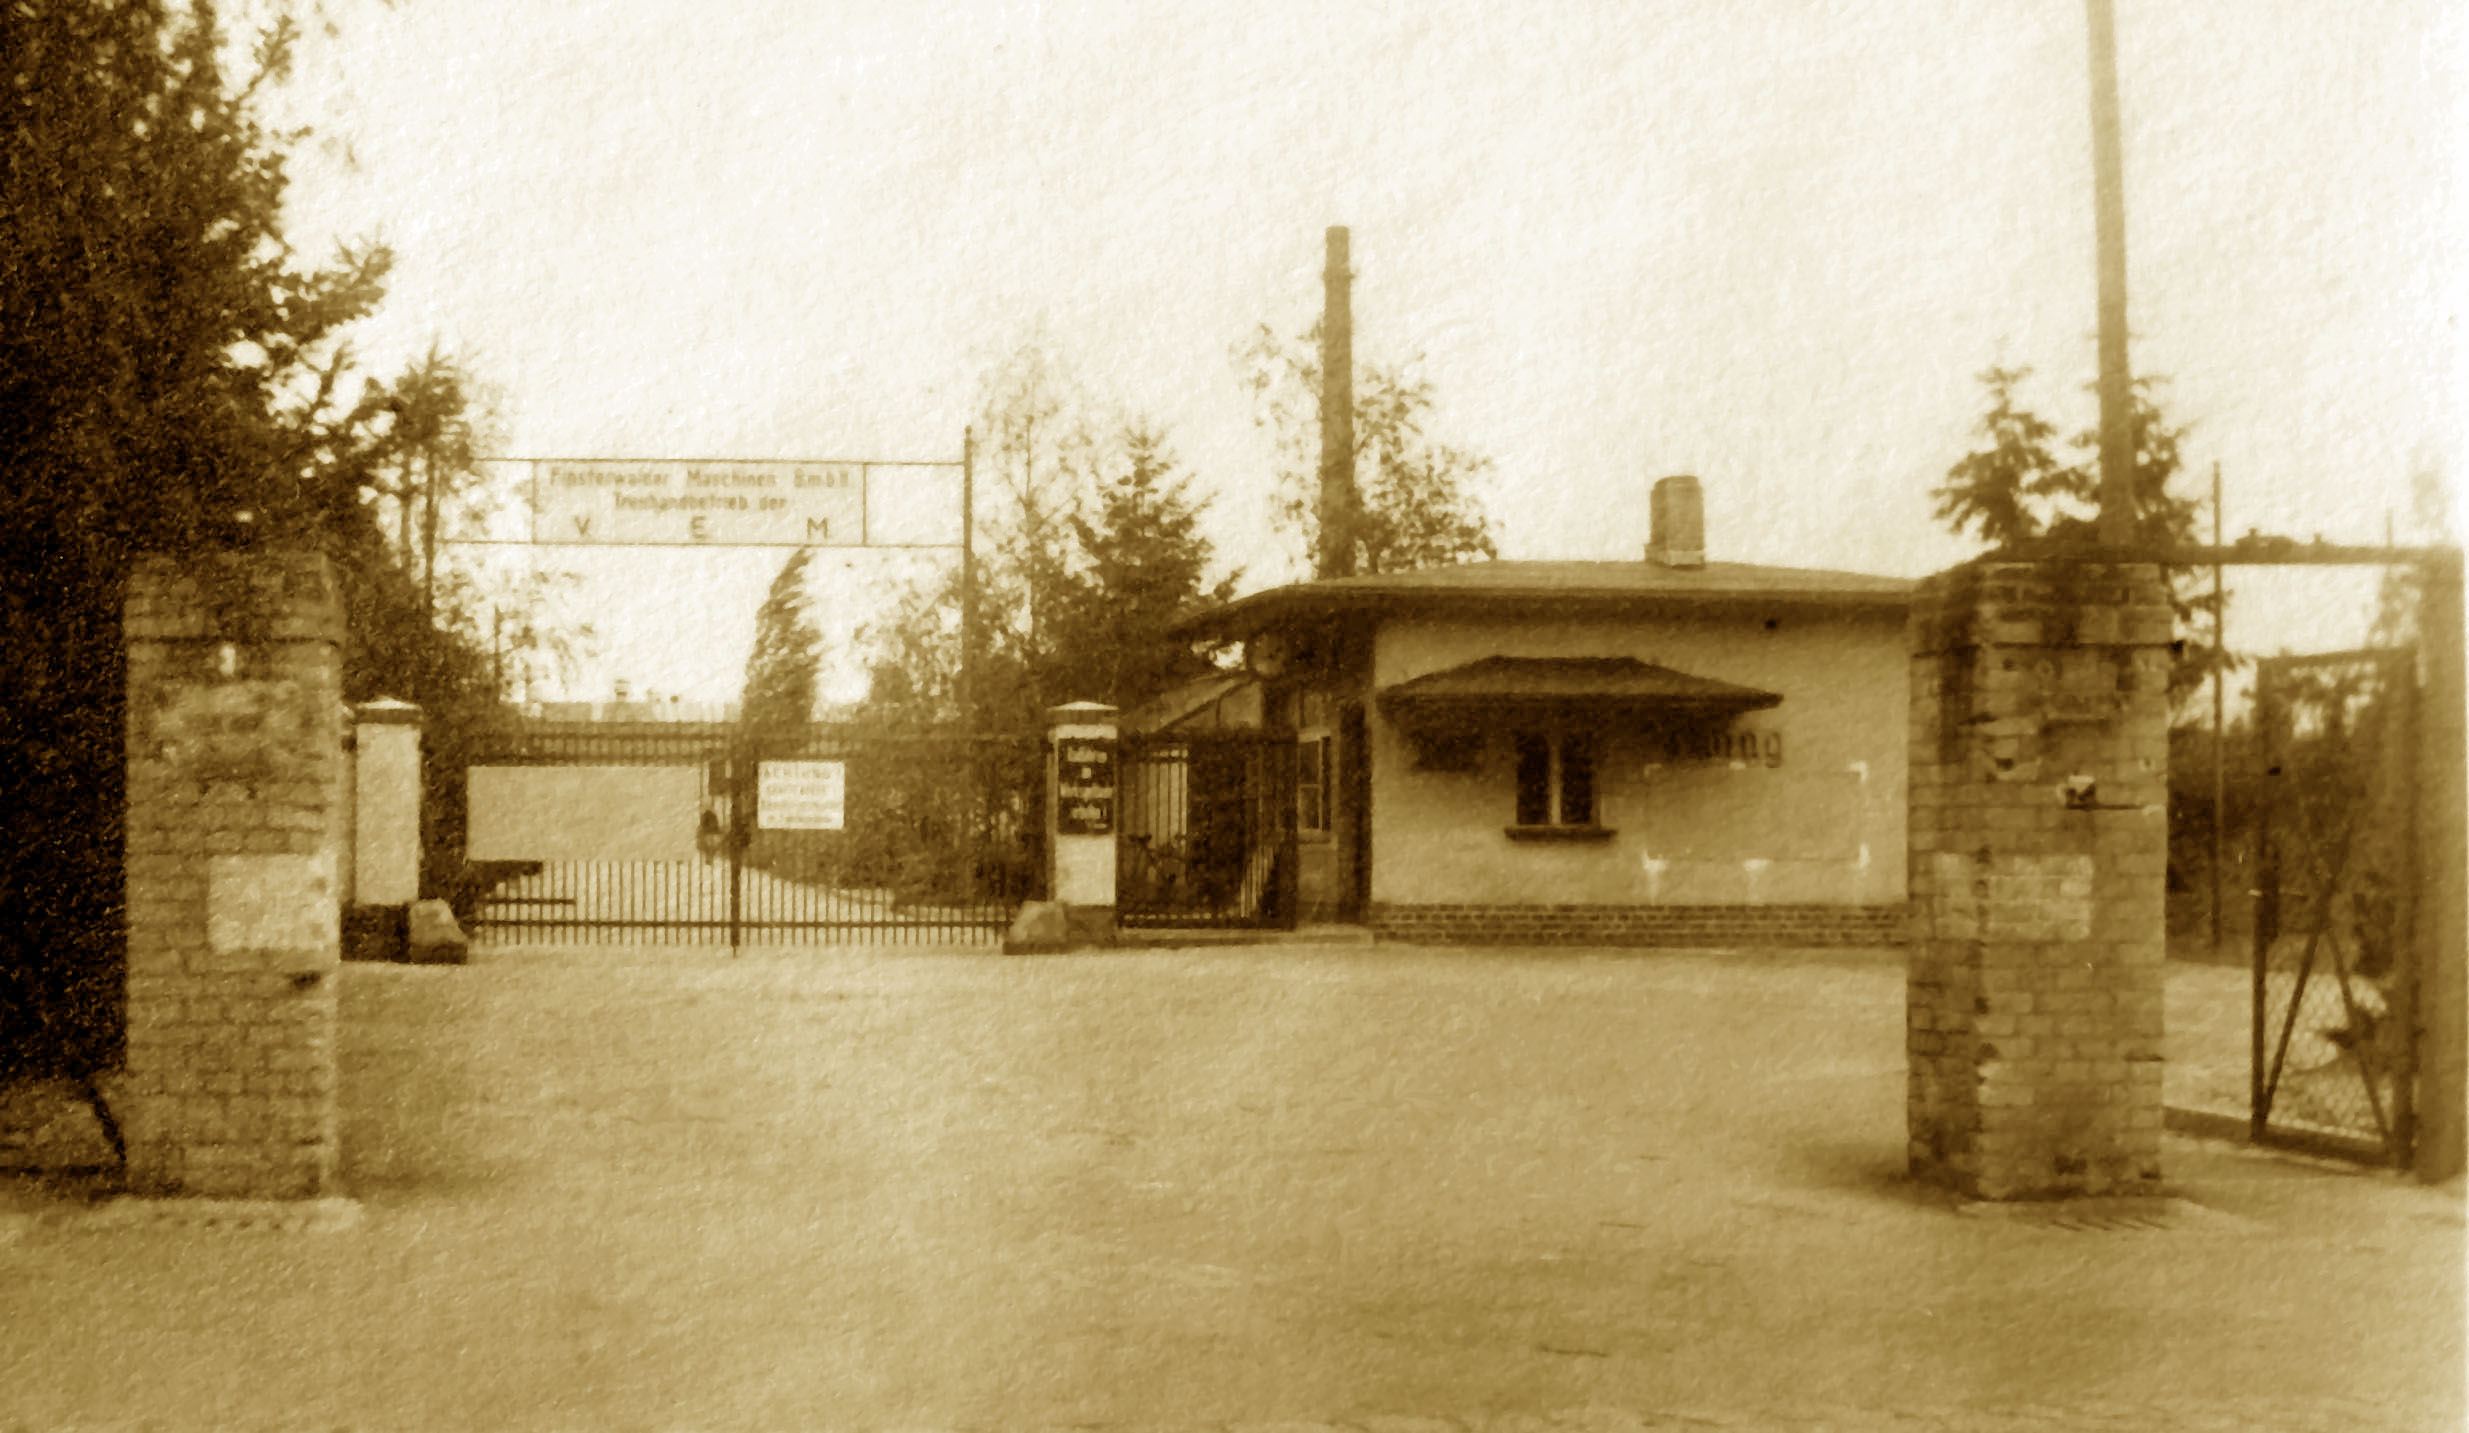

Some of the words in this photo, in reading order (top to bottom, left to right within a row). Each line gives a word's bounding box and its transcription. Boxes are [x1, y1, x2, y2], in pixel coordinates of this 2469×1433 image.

[550, 466, 668, 487] Finsterwalder
[687, 468, 777, 488] Maschinen
[759, 494, 787, 512] der
[572, 515, 591, 538] V
[690, 515, 707, 540] E
[806, 516, 829, 540] M
